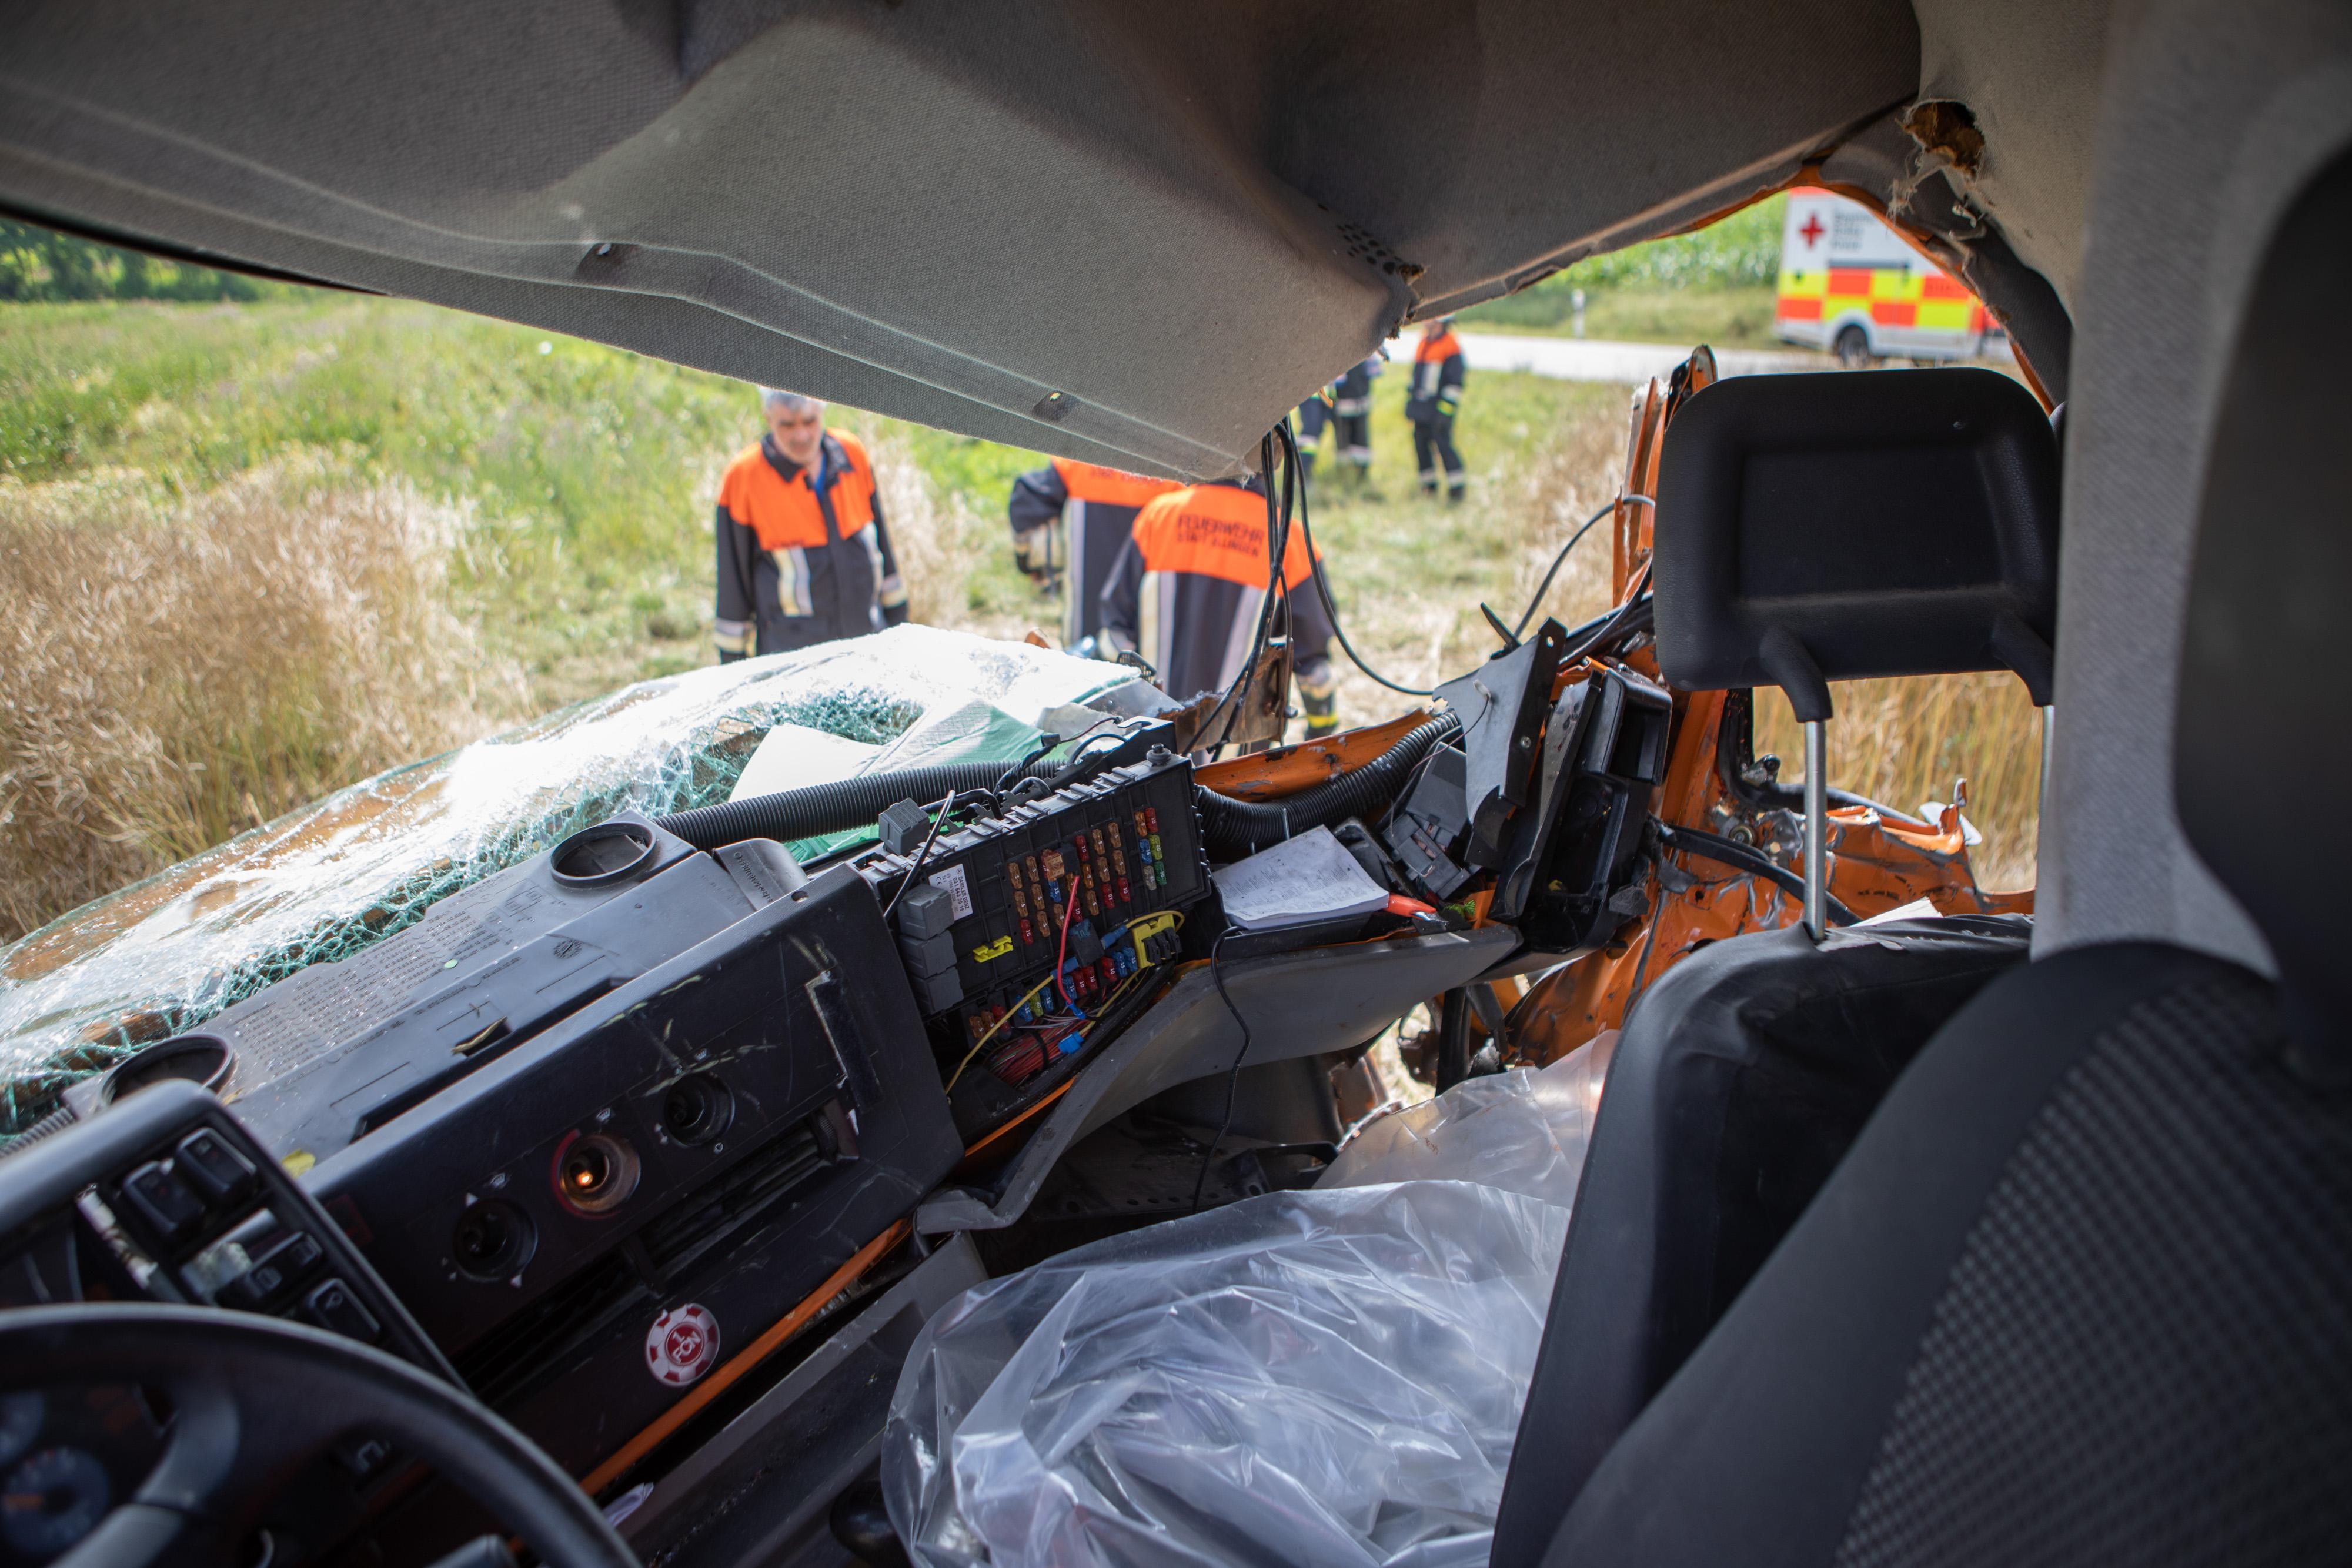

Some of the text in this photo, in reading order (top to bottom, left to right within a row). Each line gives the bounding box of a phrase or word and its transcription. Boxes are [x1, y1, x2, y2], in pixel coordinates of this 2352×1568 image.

[1178, 514, 1264, 544] FEUERWEHR
[958, 876, 967, 897] DAIMLER
[672, 1330, 701, 1364] FCN
